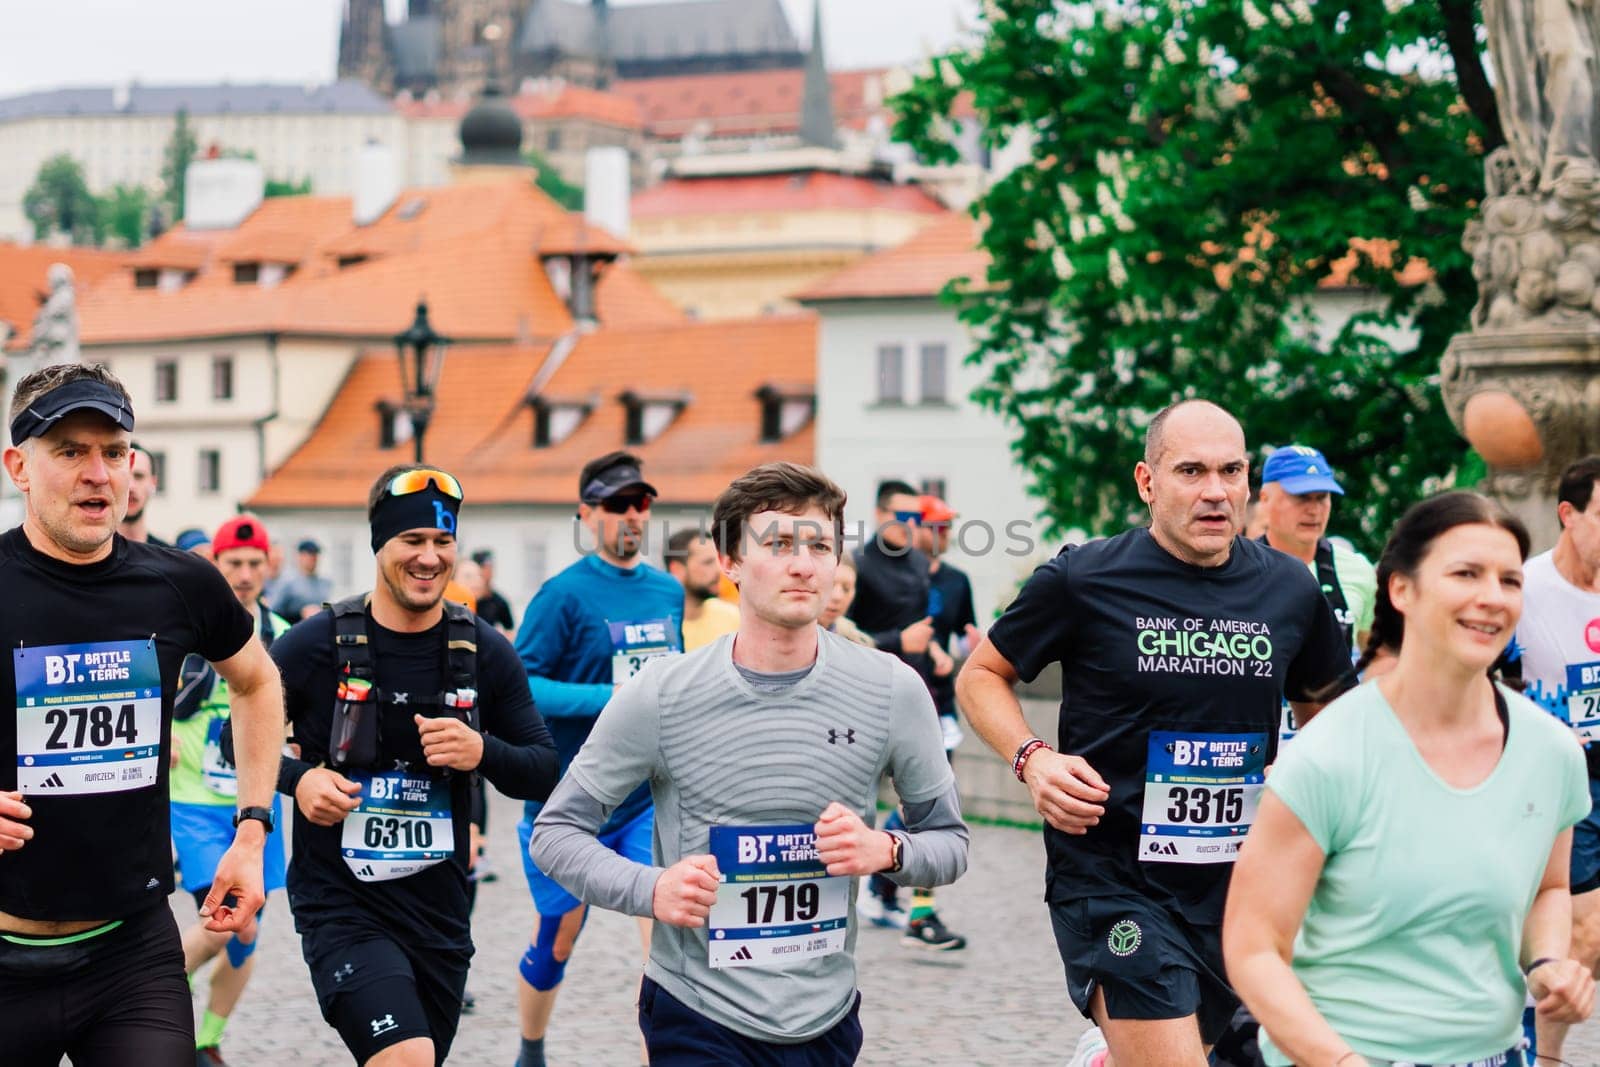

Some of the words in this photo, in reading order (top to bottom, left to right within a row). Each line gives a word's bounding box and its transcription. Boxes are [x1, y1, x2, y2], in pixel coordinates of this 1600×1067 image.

[1136, 617, 1177, 631] BANK
[1183, 618, 1204, 631] OF
[1209, 619, 1271, 636] AMERICA
[1137, 629, 1273, 661] CHICAGO
[84, 650, 131, 665] BATTLE
[1137, 656, 1245, 676] MARATHON
[88, 668, 130, 682] TEAMS
[45, 703, 138, 750] 2784
[1209, 741, 1247, 752] BATTLE
[1211, 756, 1244, 767] TEAMS
[401, 779, 431, 790] BATTLE
[402, 791, 428, 802] TEAMS
[1167, 786, 1244, 824] 3315
[364, 816, 433, 849] 6310
[777, 834, 816, 847] BATTL
[780, 850, 820, 862] TEAMS
[740, 883, 820, 924] 1719
